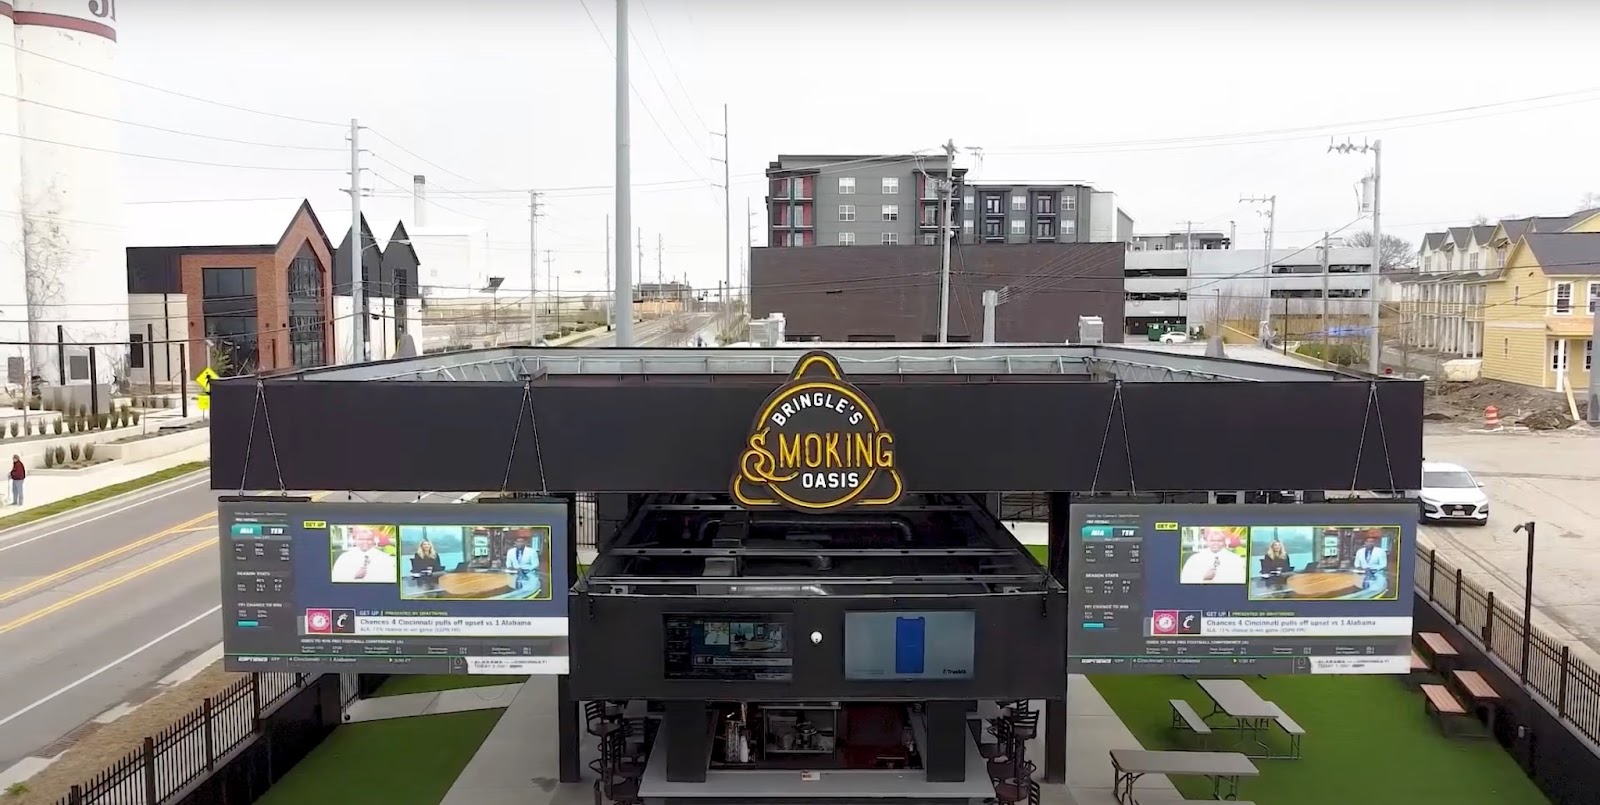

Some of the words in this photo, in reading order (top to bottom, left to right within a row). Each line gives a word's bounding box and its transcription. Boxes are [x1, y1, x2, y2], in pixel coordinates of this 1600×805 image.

[772, 392, 864, 426] BRINGLE'S
[741, 427, 893, 482] SMOKING
[802, 472, 859, 488] OASIS
[1280, 620, 1298, 628] pulls
